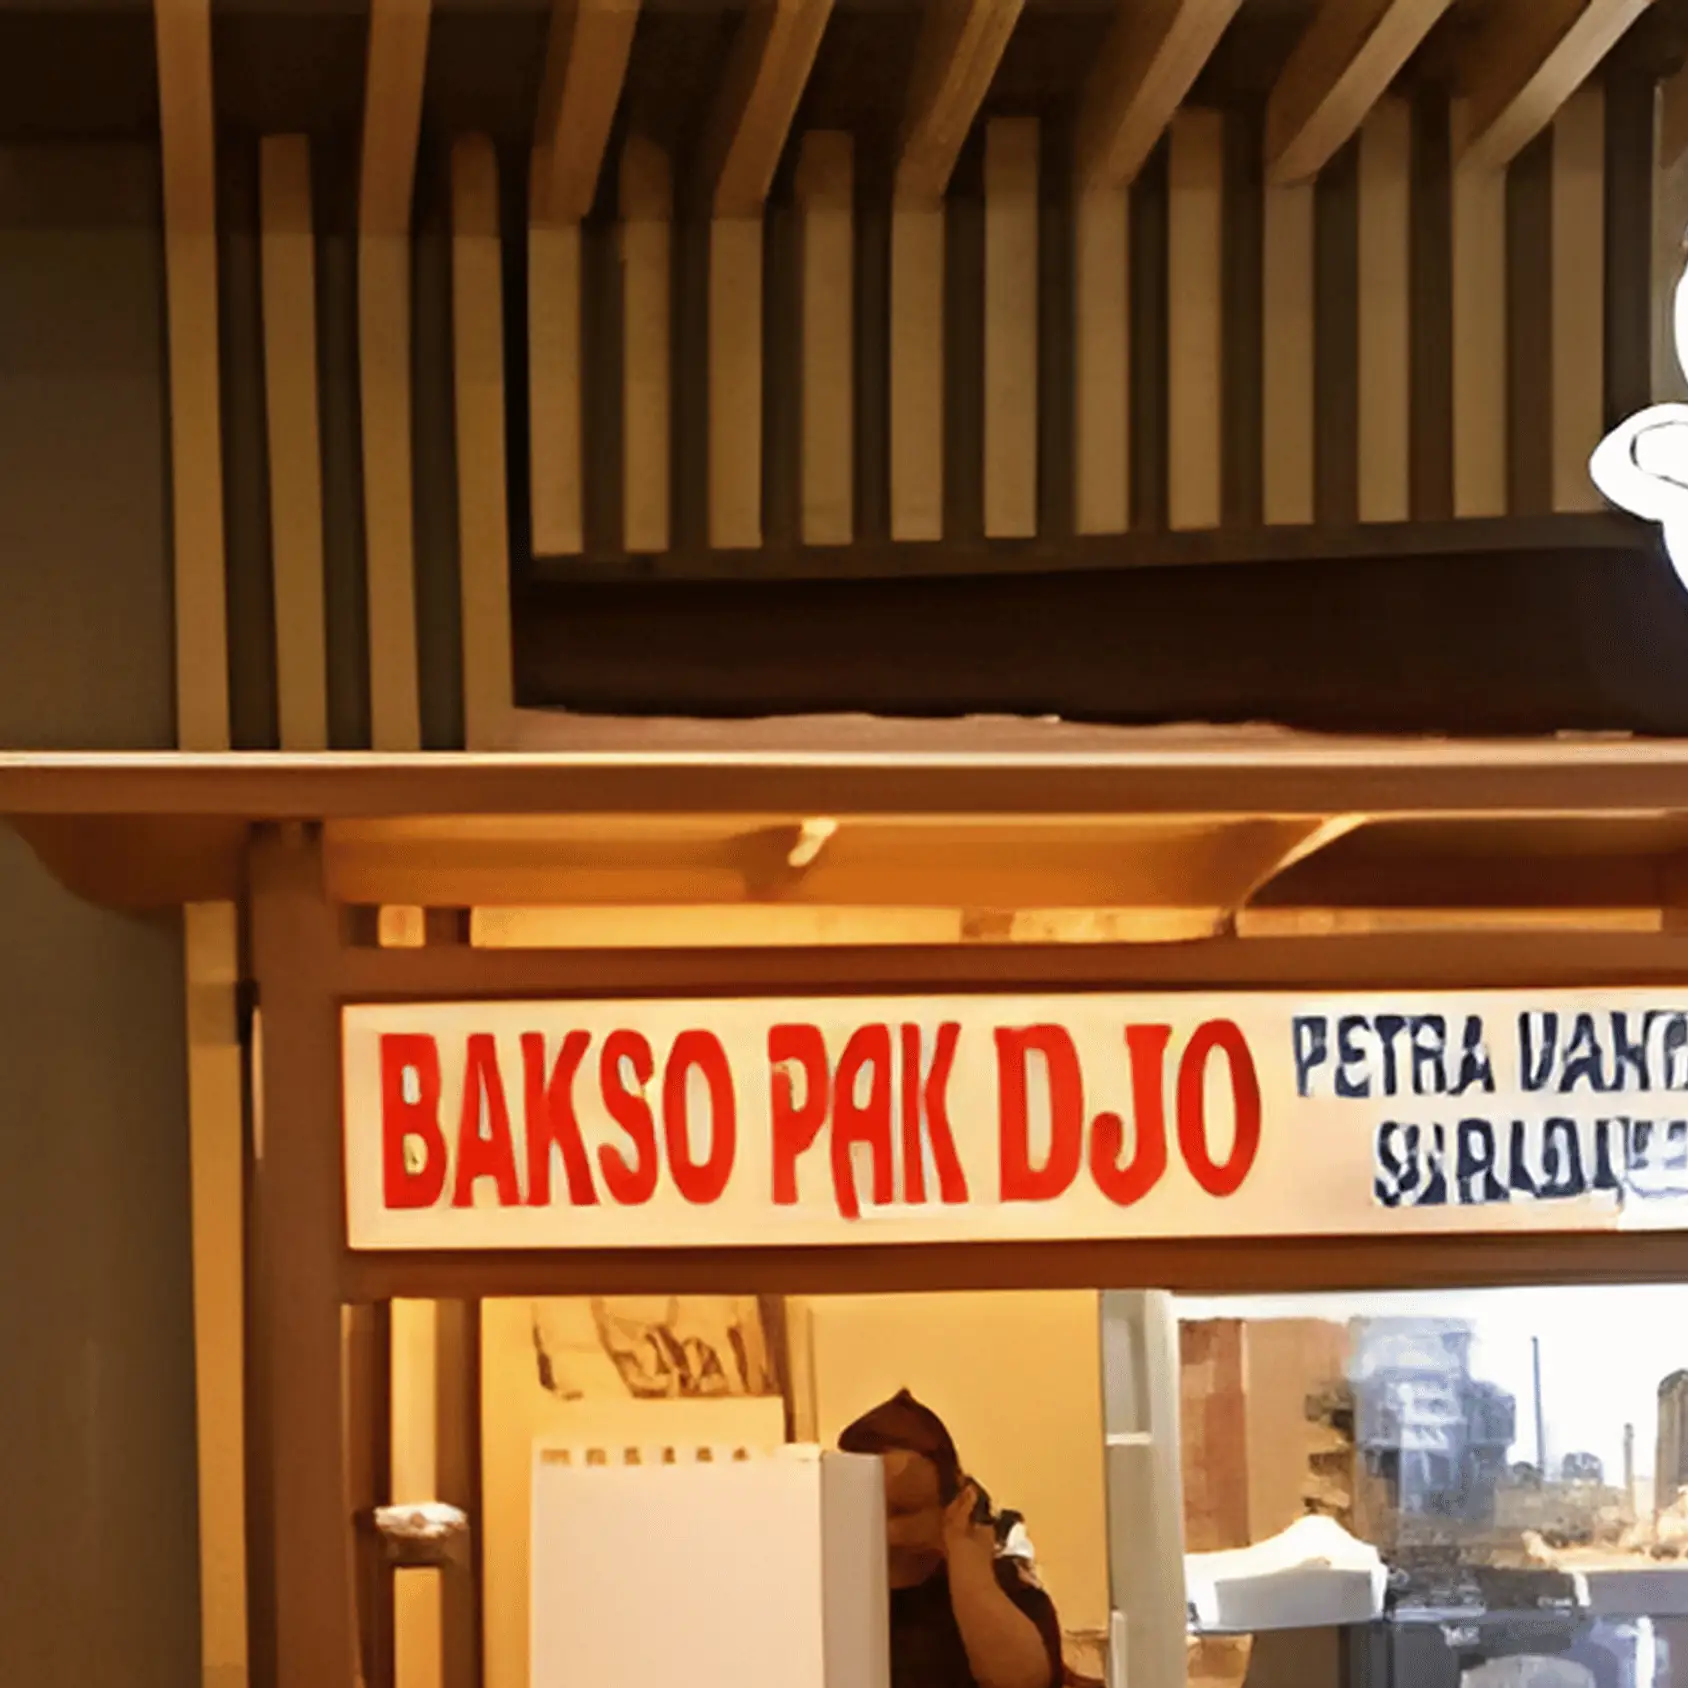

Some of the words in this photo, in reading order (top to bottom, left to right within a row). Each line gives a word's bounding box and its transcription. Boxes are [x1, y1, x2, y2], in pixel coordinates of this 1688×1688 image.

[378, 1028, 737, 1209] BAKSO
[767, 1021, 970, 1220] PAK
[993, 1017, 1262, 1208] DJO
